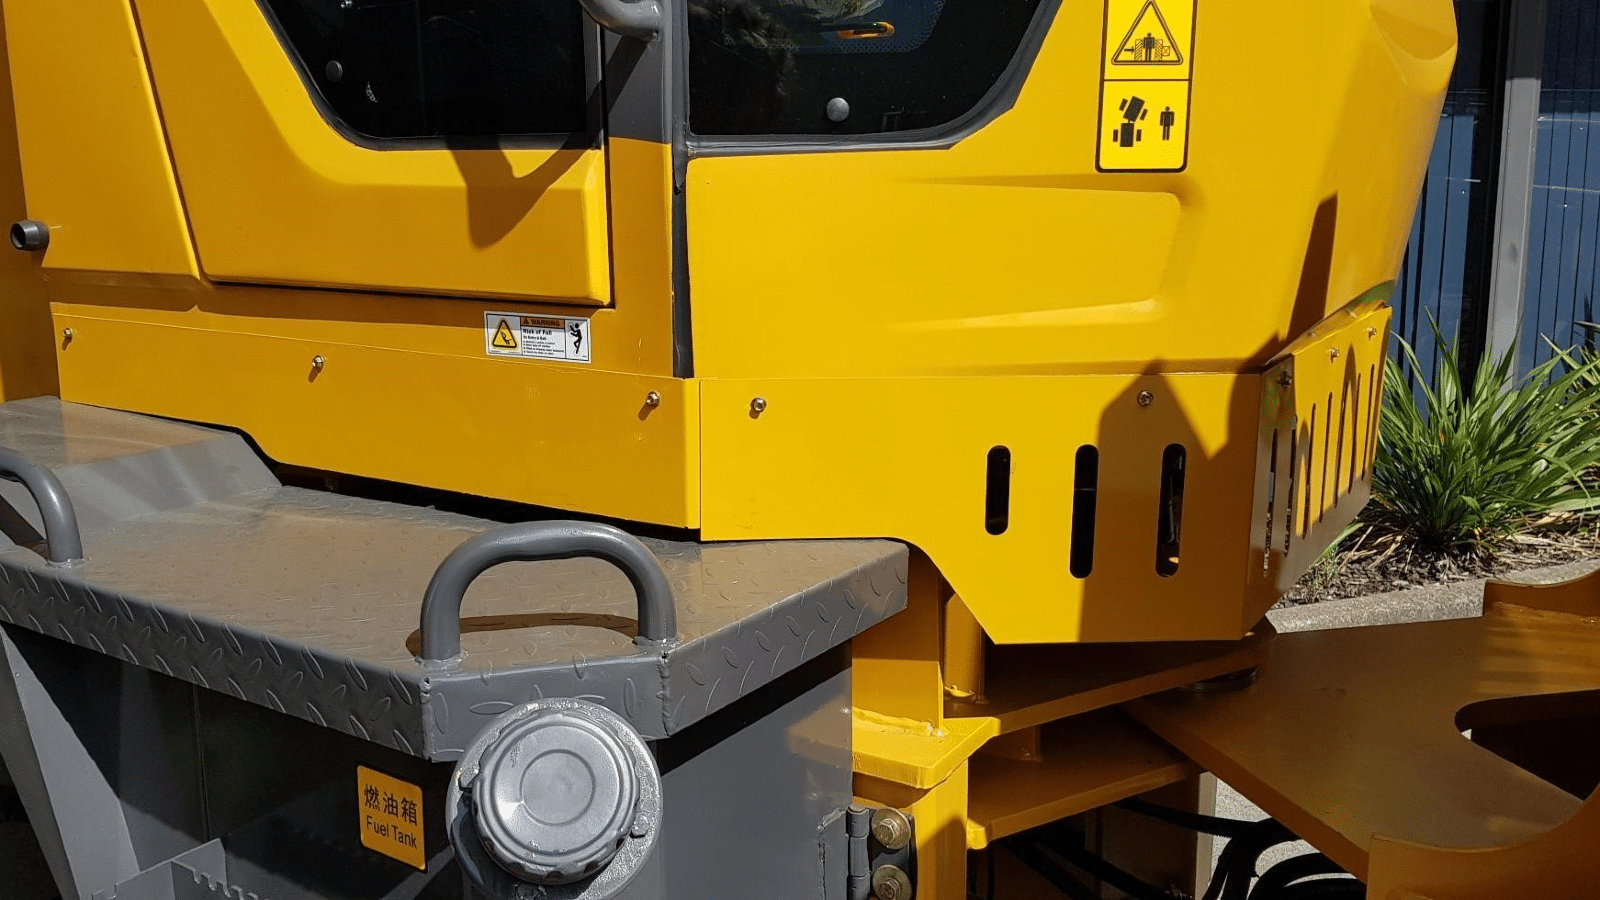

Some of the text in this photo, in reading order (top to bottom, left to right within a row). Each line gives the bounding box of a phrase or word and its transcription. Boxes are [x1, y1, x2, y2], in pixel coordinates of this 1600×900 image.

[531, 318, 560, 327] WARNING
[364, 783, 417, 826] 燃油箱
[366, 815, 417, 850] Fuel Tank
